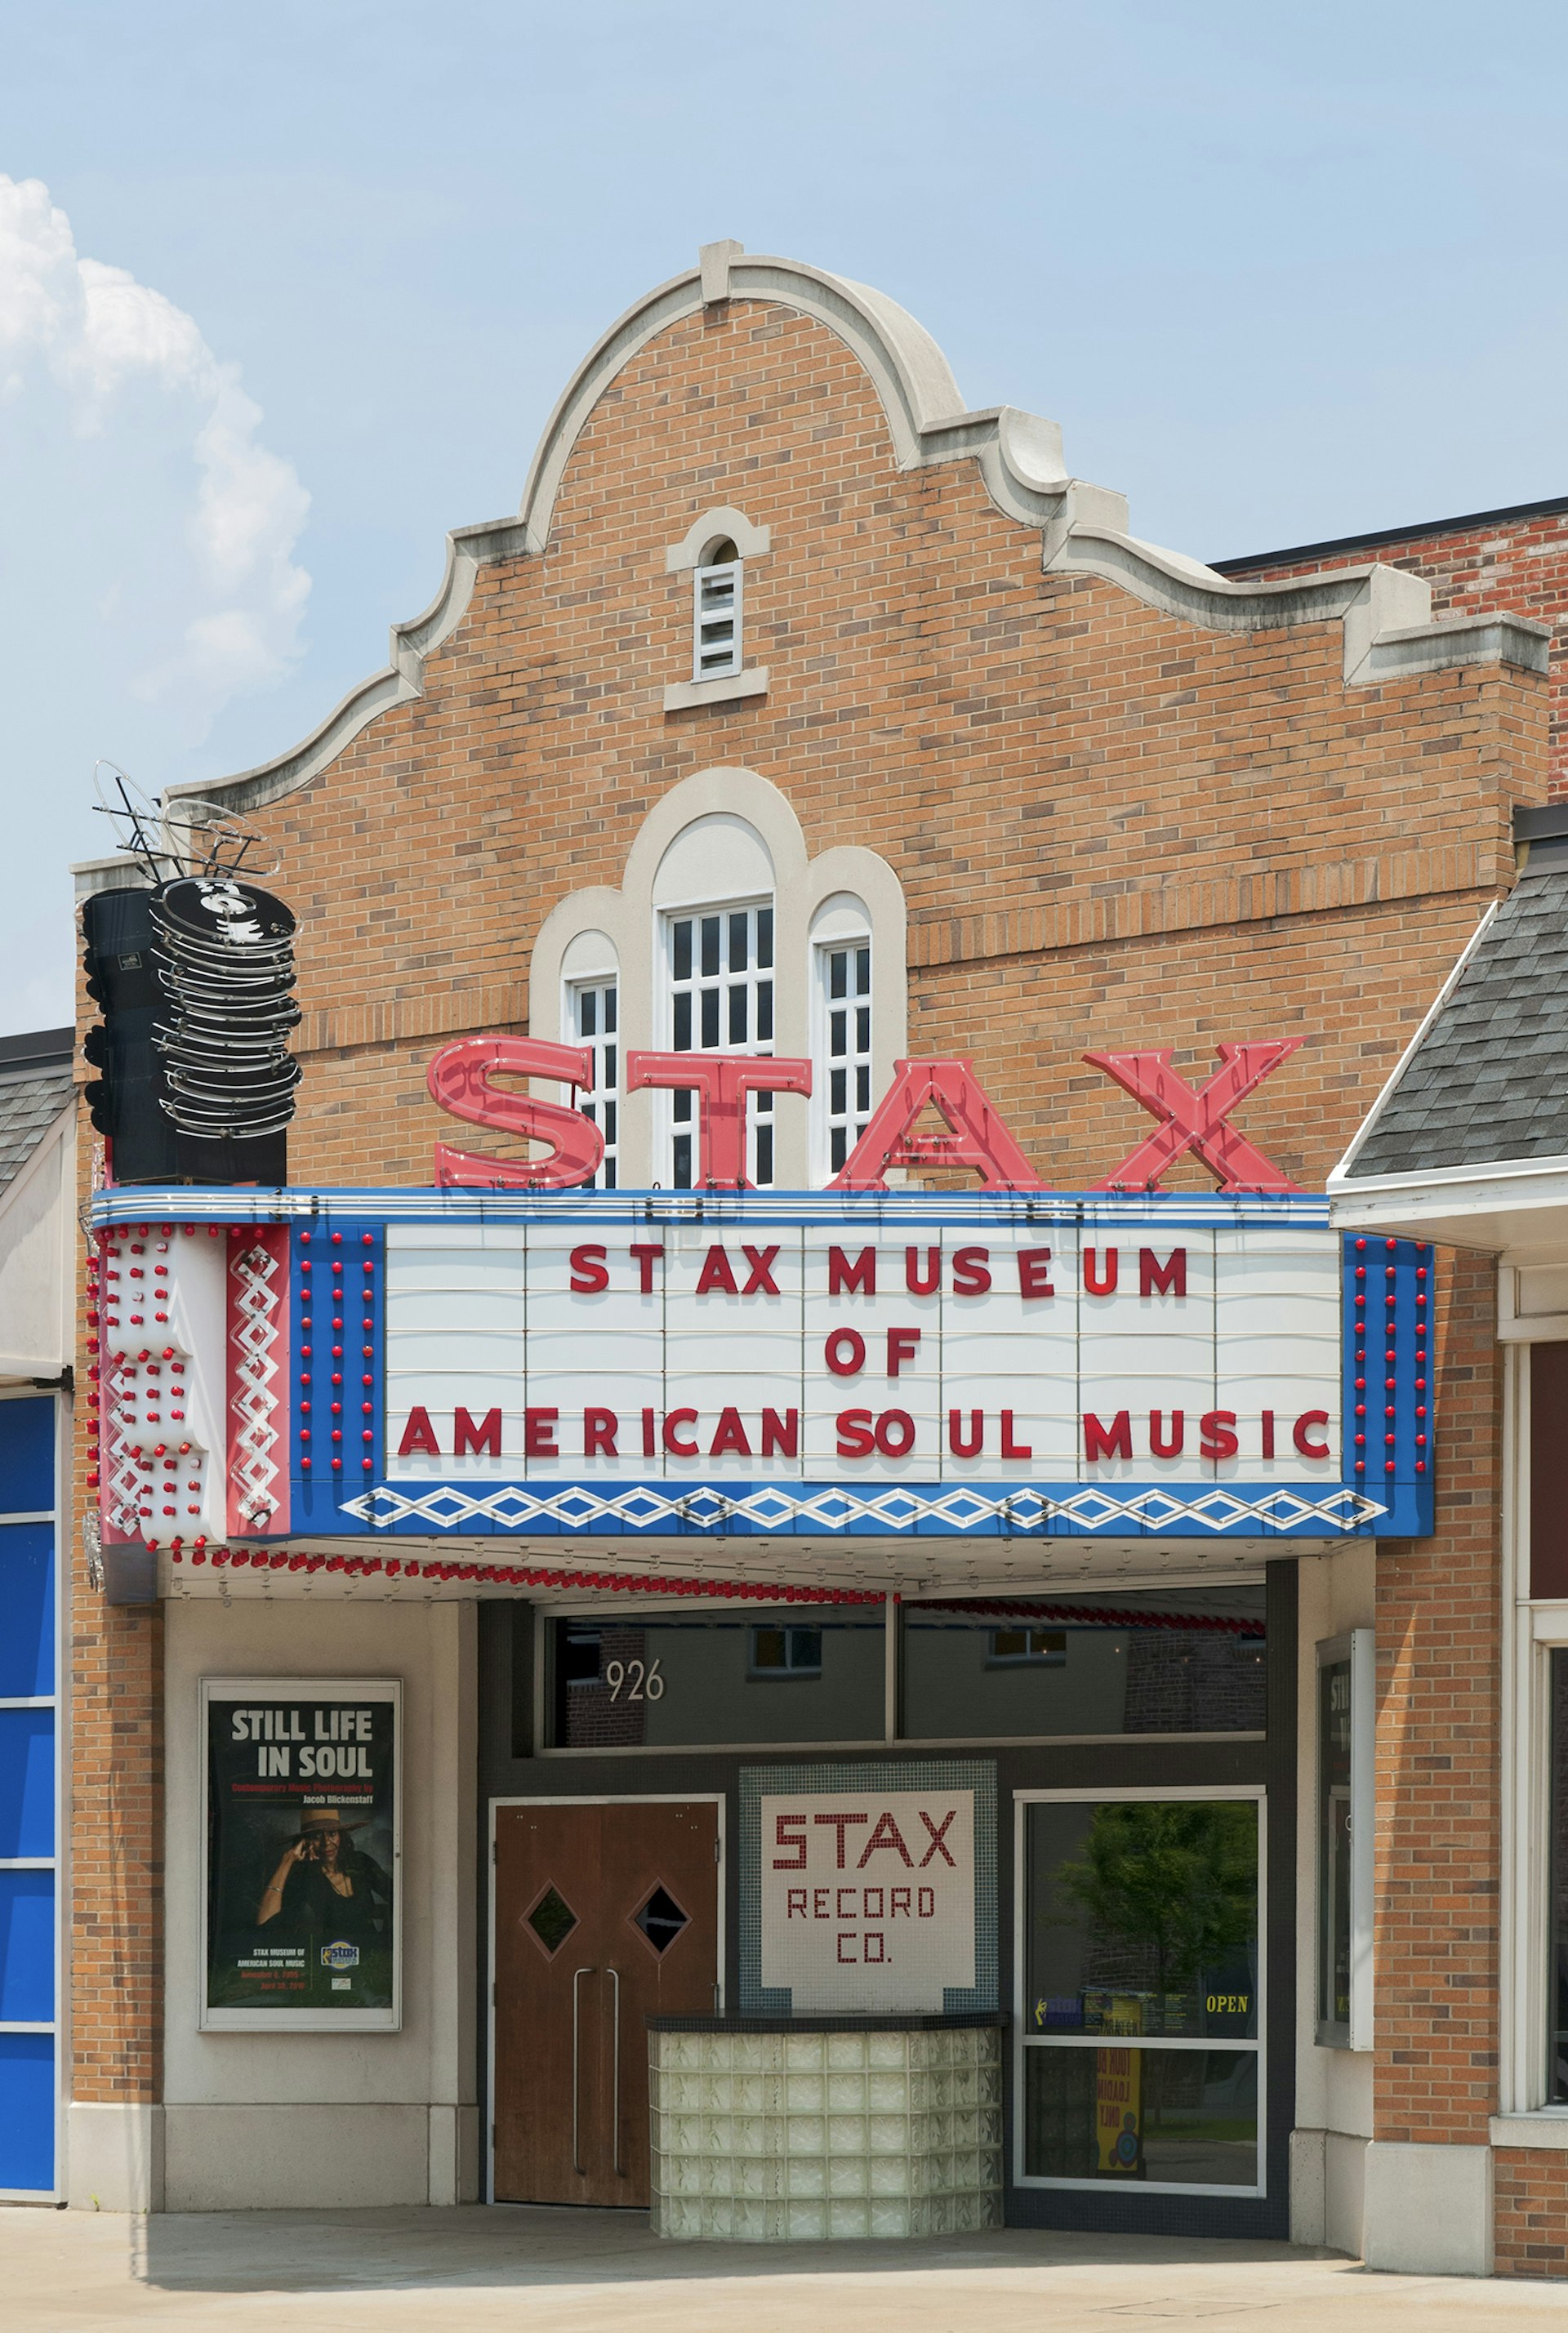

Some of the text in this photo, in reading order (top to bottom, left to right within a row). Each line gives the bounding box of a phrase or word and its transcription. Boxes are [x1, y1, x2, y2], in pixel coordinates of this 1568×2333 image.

[426, 1034, 1307, 1193] STAX
[569, 1244, 1187, 1298] STAX MUSEUM
[825, 1327, 921, 1377] OF
[398, 1406, 1330, 1461] AMERICAN SOUL MUSIC
[606, 1658, 666, 1703] 926
[231, 1709, 373, 1741] STILL LIFE
[257, 1746, 373, 1777] IN SOUL
[303, 1795, 373, 1804] Jacob Blickenstaff
[773, 1810, 957, 1870] STAX
[787, 1887, 935, 1919] RECORD
[237, 1959, 305, 1968] AMERICAN SOUL MUSIC
[253, 1948, 305, 1957] STAX MUSEUM OF
[837, 1932, 893, 1964] CO.
[1206, 1995, 1249, 2014] OPEN
